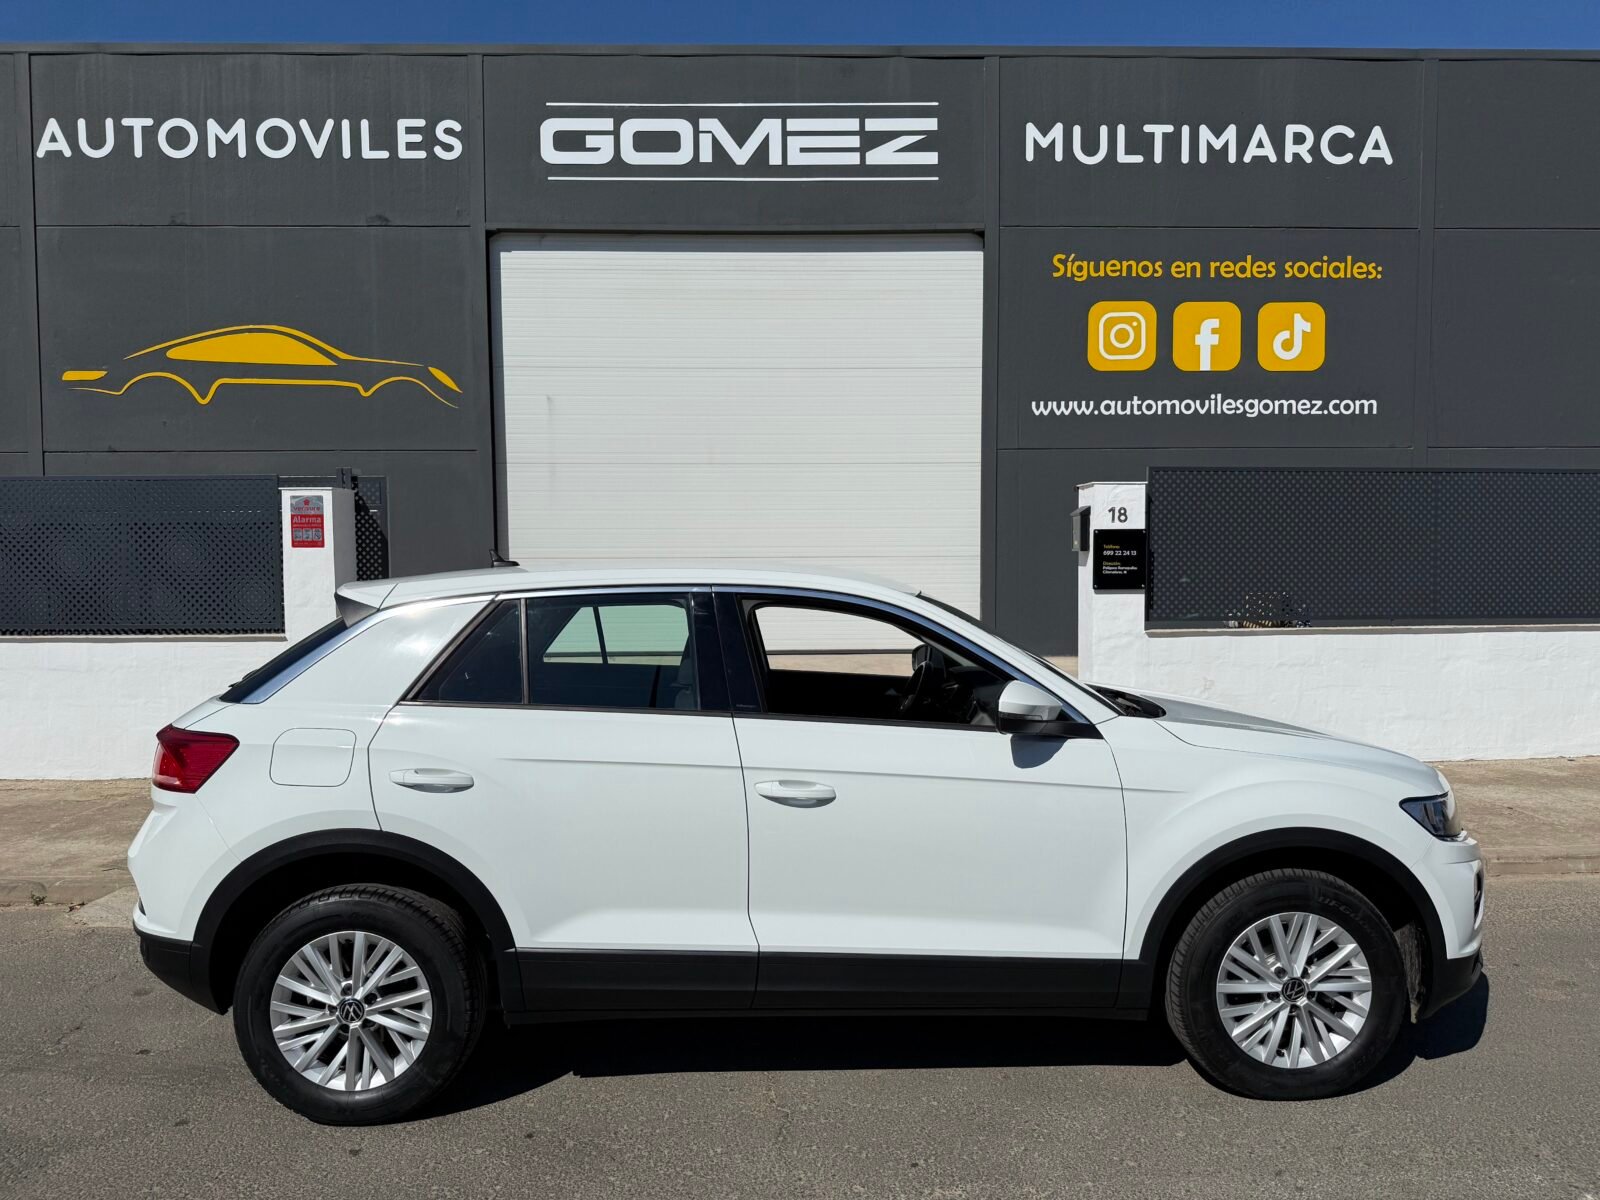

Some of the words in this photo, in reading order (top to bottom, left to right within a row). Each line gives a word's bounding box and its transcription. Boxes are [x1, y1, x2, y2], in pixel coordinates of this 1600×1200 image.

[36, 117, 463, 161] AUTOMOVILES
[539, 117, 939, 166] GOMEZ
[1025, 122, 1394, 165] MULTIMARCA
[1052, 253, 1163, 282] Síguenos
[1170, 262, 1201, 278] en
[1210, 255, 1276, 278] redes
[1284, 255, 1384, 280] sociales:
[1031, 393, 1378, 418] www.automovilesgomez.com
[1107, 507, 1128, 523] 18
